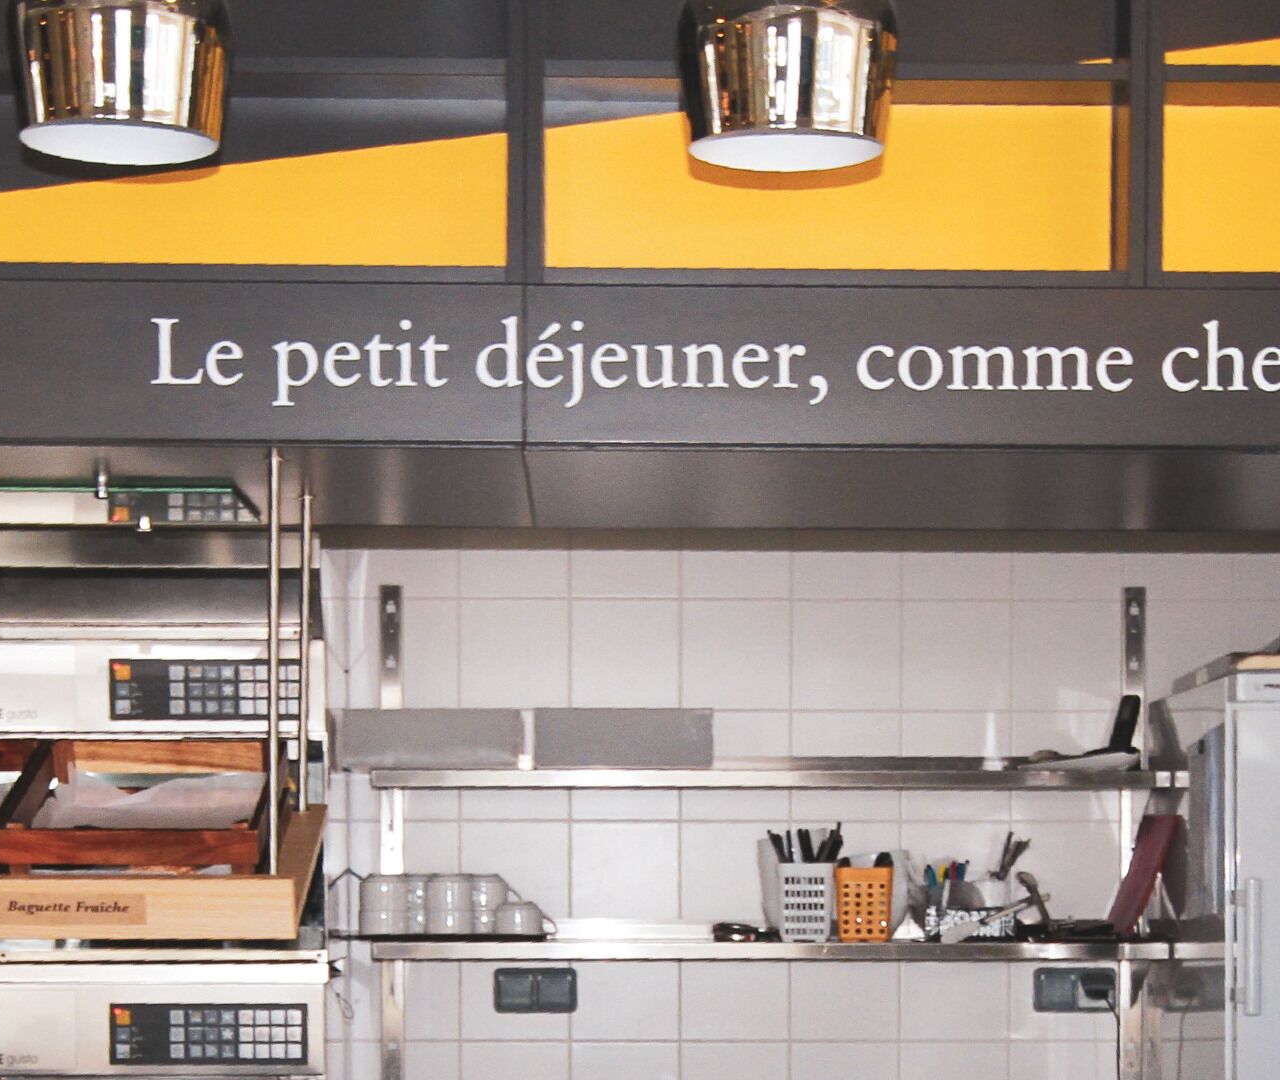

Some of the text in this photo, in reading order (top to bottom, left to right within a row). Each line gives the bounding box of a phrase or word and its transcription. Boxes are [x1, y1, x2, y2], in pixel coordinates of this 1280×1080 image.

[150, 317, 244, 387] Le
[271, 319, 450, 407] petit
[475, 315, 829, 408] déjeuner,
[855, 344, 1134, 392] comme
[7, 900, 72, 915] Baguette
